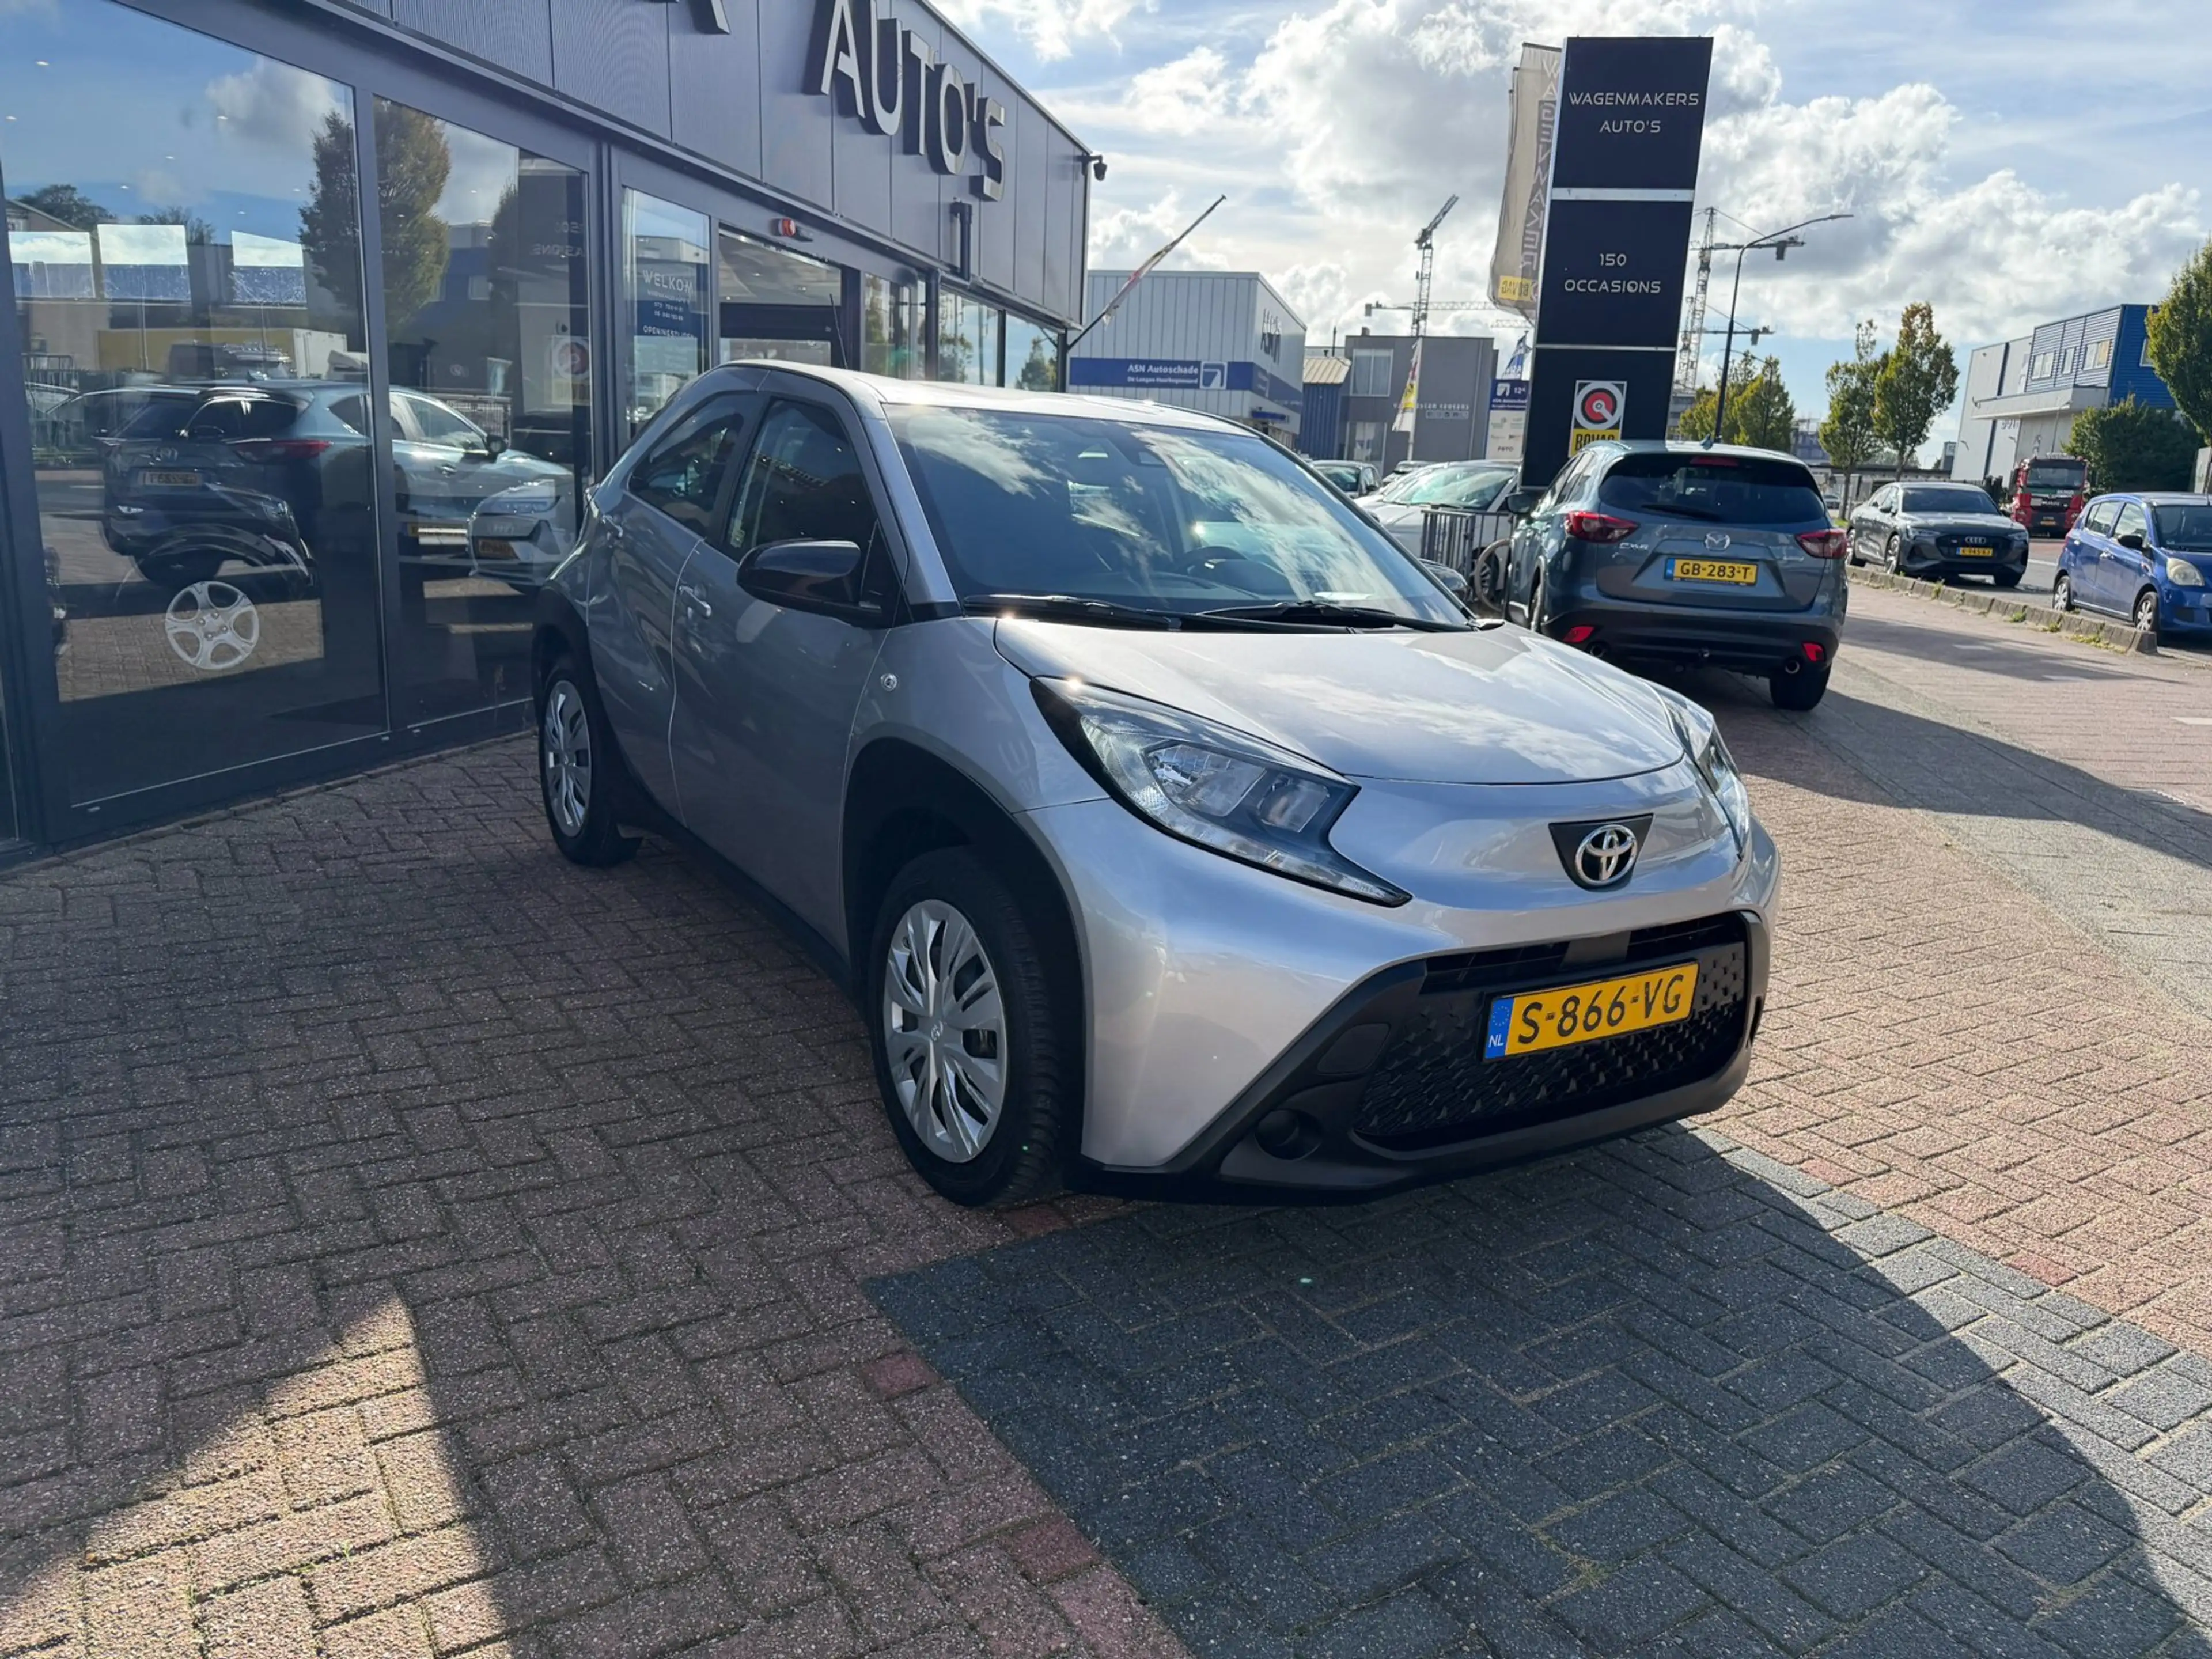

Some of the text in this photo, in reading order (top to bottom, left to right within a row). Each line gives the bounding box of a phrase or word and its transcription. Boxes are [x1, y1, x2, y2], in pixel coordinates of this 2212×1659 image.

[815, 0, 1005, 202] AUTO'S
[1569, 92, 1699, 105] WAGENMAKERS
[1599, 120, 1661, 133] AUTO'S
[1599, 253, 1627, 266] 150
[643, 269, 694, 294] WELKOM
[1565, 279, 1661, 293] OCCASIONS
[1127, 363, 1198, 374] ASN Autoschade
[1680, 562, 1751, 580] GB-283-T
[1488, 974, 1684, 1048] NL S-866-VG
